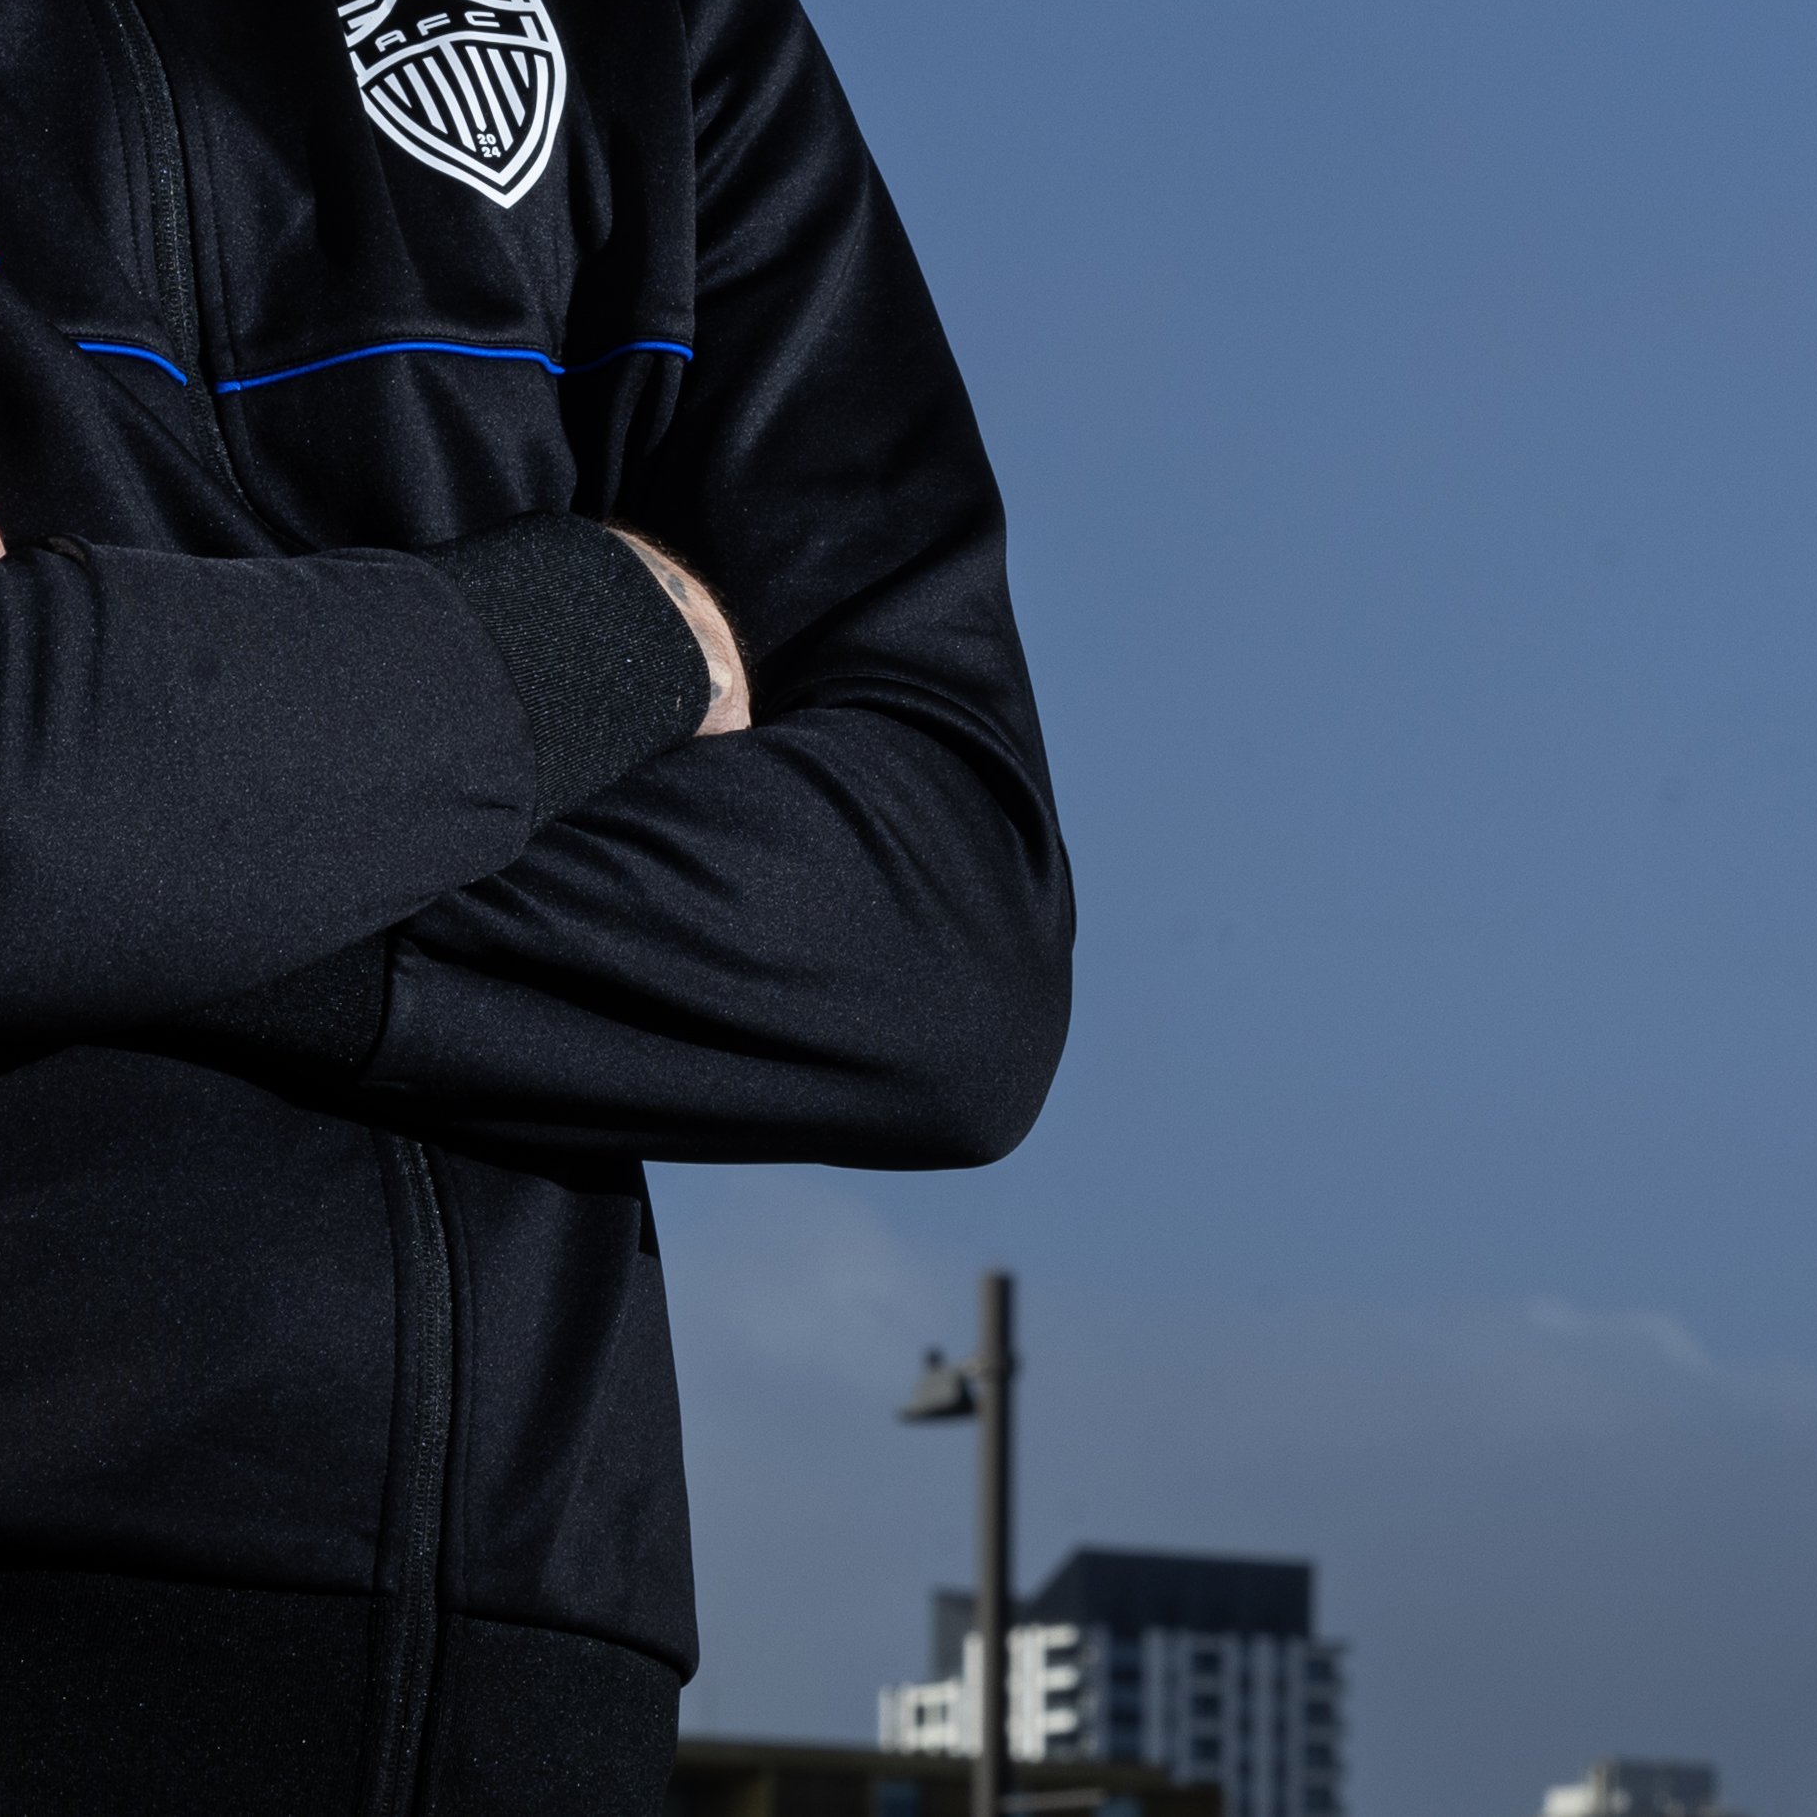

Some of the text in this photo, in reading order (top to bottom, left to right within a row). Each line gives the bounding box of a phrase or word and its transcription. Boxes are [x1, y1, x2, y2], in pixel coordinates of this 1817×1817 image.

[374, 10, 501, 53] AFC
[476, 133, 497, 145] 20
[481, 145, 502, 158] 24
